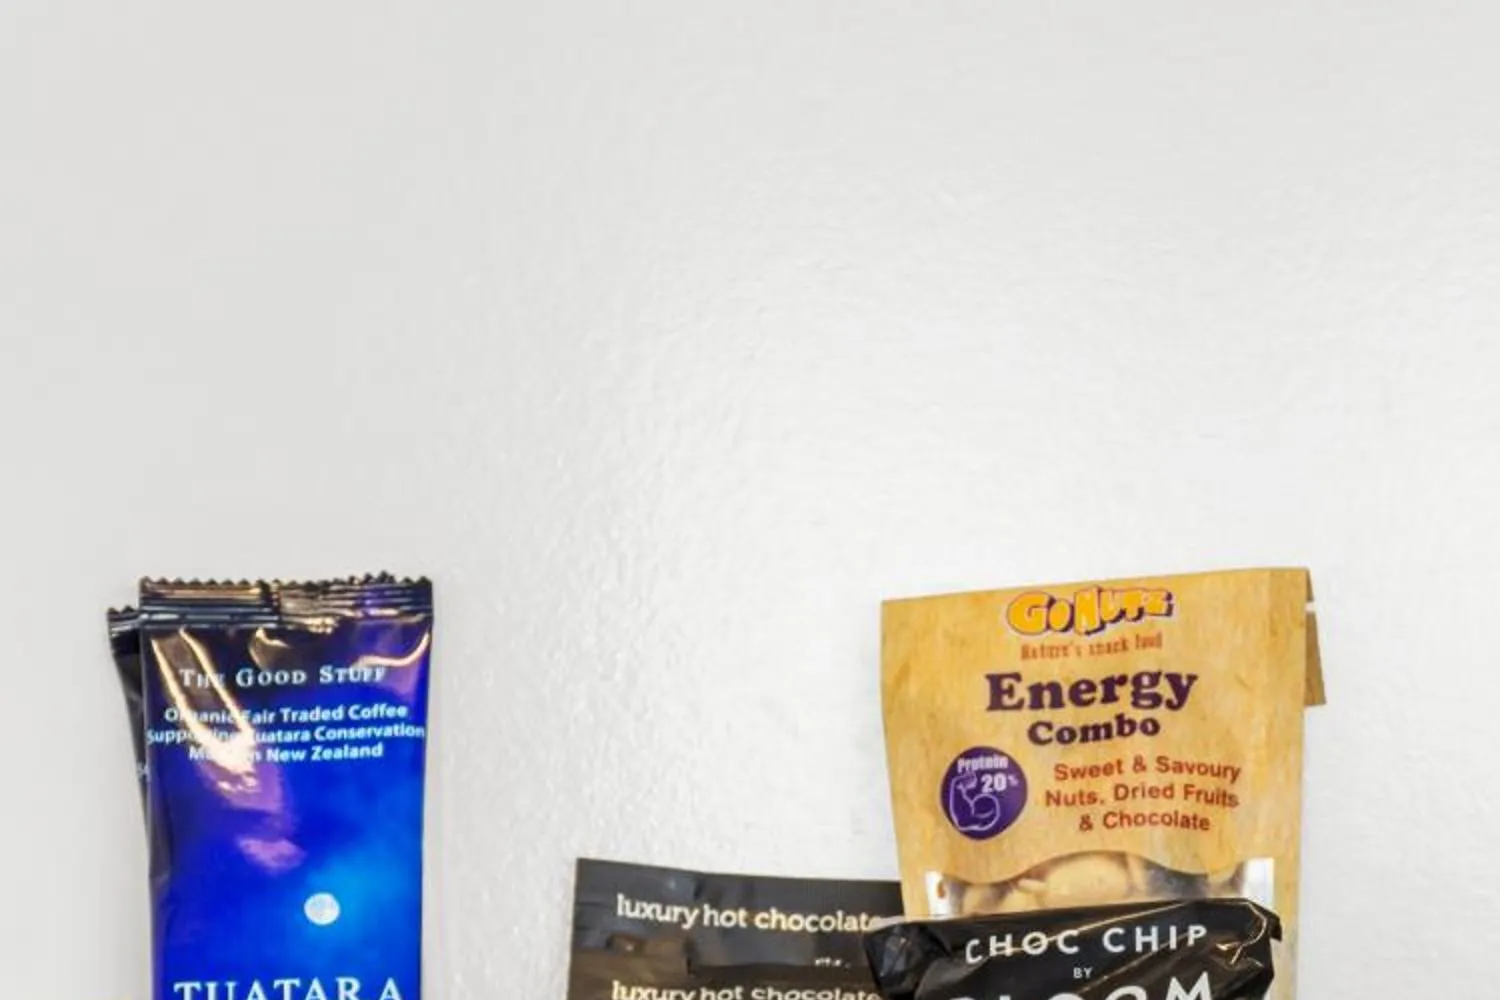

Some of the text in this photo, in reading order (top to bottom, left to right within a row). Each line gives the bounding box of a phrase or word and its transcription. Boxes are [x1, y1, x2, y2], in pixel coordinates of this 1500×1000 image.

[1089, 637, 1128, 656] snack
[1135, 631, 1163, 650] food
[985, 668, 1198, 712] Energy
[165, 708, 236, 726] Oanic
[279, 705, 344, 723] Traded
[348, 702, 408, 720] Coffee
[247, 728, 311, 744] uatara
[314, 722, 427, 742] Conservation
[1027, 713, 1161, 746] Combo
[266, 747, 306, 763] New
[311, 741, 385, 762] Zealand
[1054, 755, 1241, 785] Sweet & Savoury
[1114, 782, 1175, 801] Dried
[1183, 783, 1240, 808] Fruits
[1079, 810, 1210, 832] & Chocolate
[617, 893, 700, 930] luxury
[703, 905, 748, 928] hot
[965, 924, 1208, 965] CHOC CHIP
[1073, 966, 1093, 980] BY
